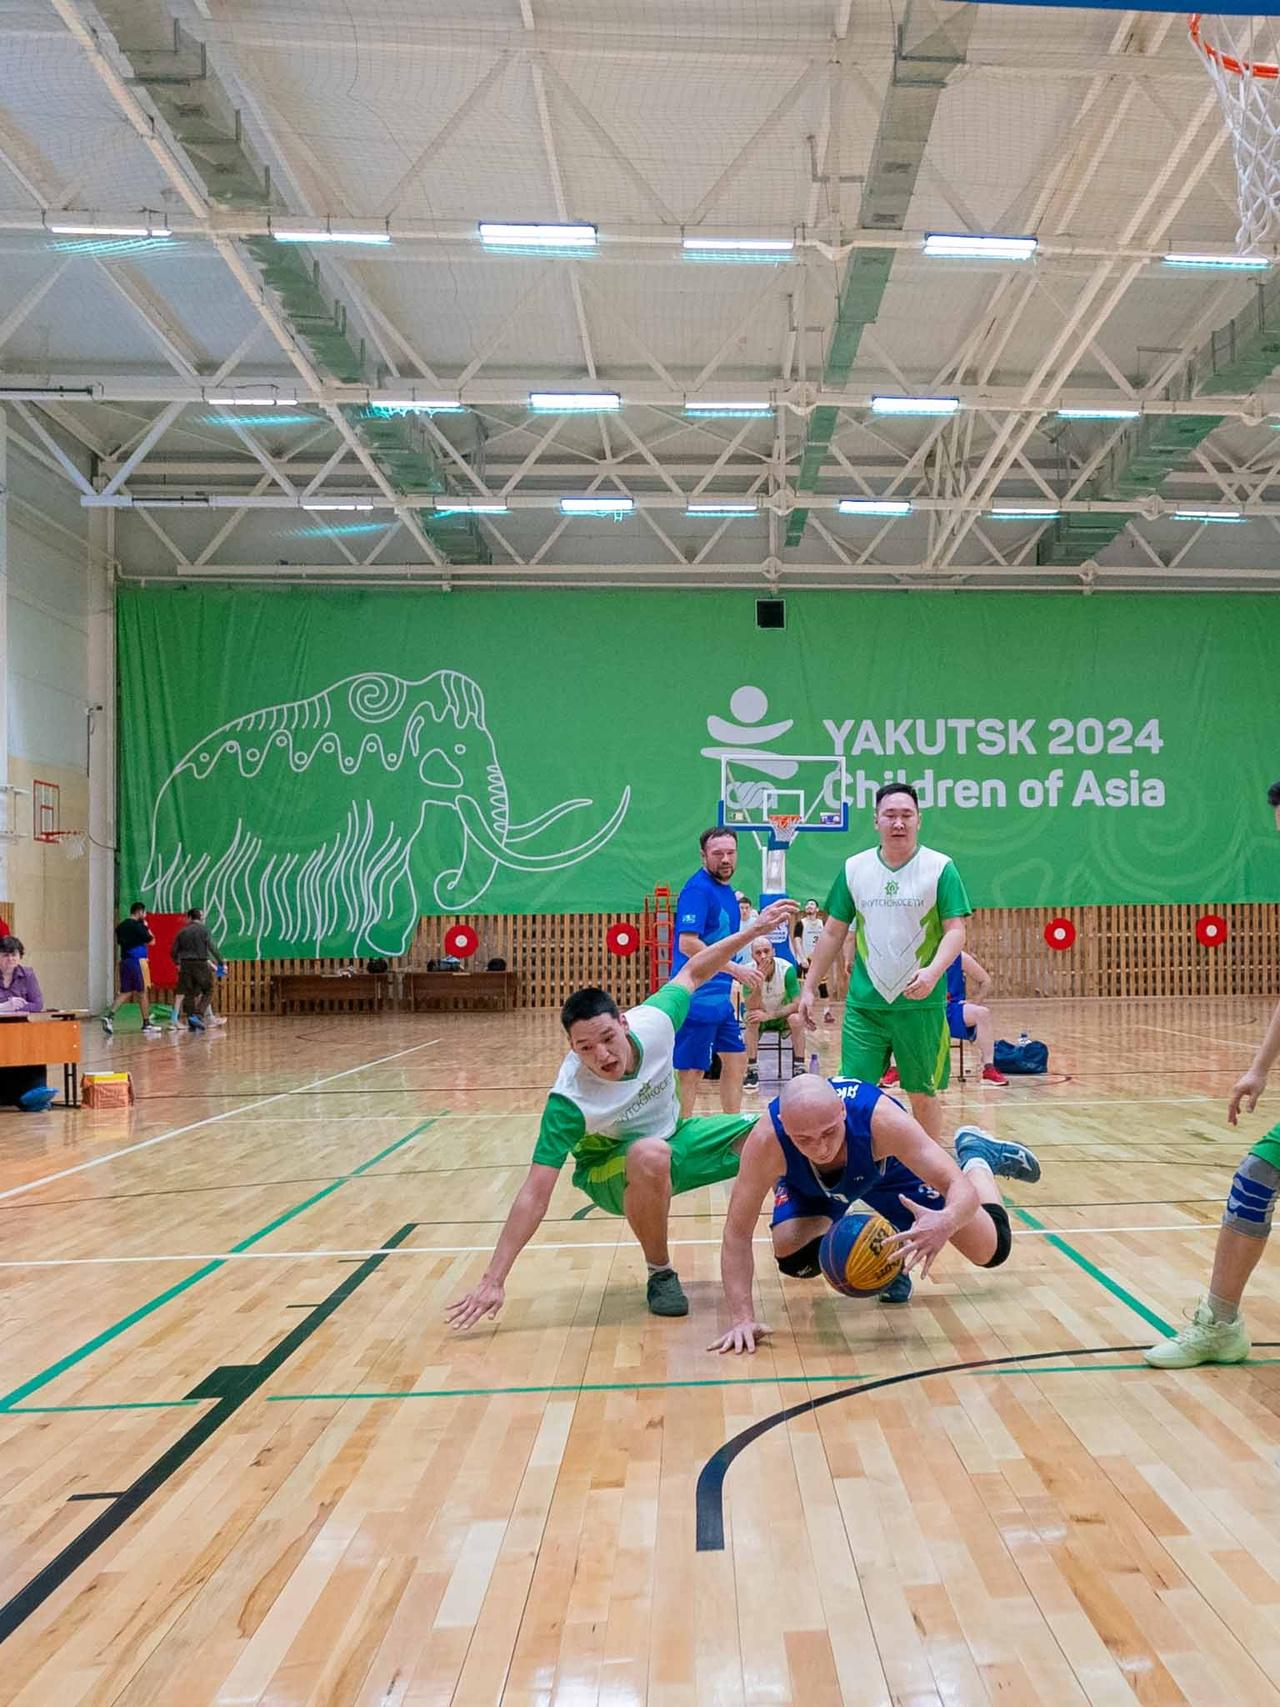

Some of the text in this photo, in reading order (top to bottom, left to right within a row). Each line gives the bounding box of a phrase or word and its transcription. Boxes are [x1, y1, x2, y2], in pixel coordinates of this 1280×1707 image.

[823, 717, 1164, 756] YAKUTSK 2024
[1019, 769, 1064, 808] of
[1072, 769, 1165, 808] Asia
